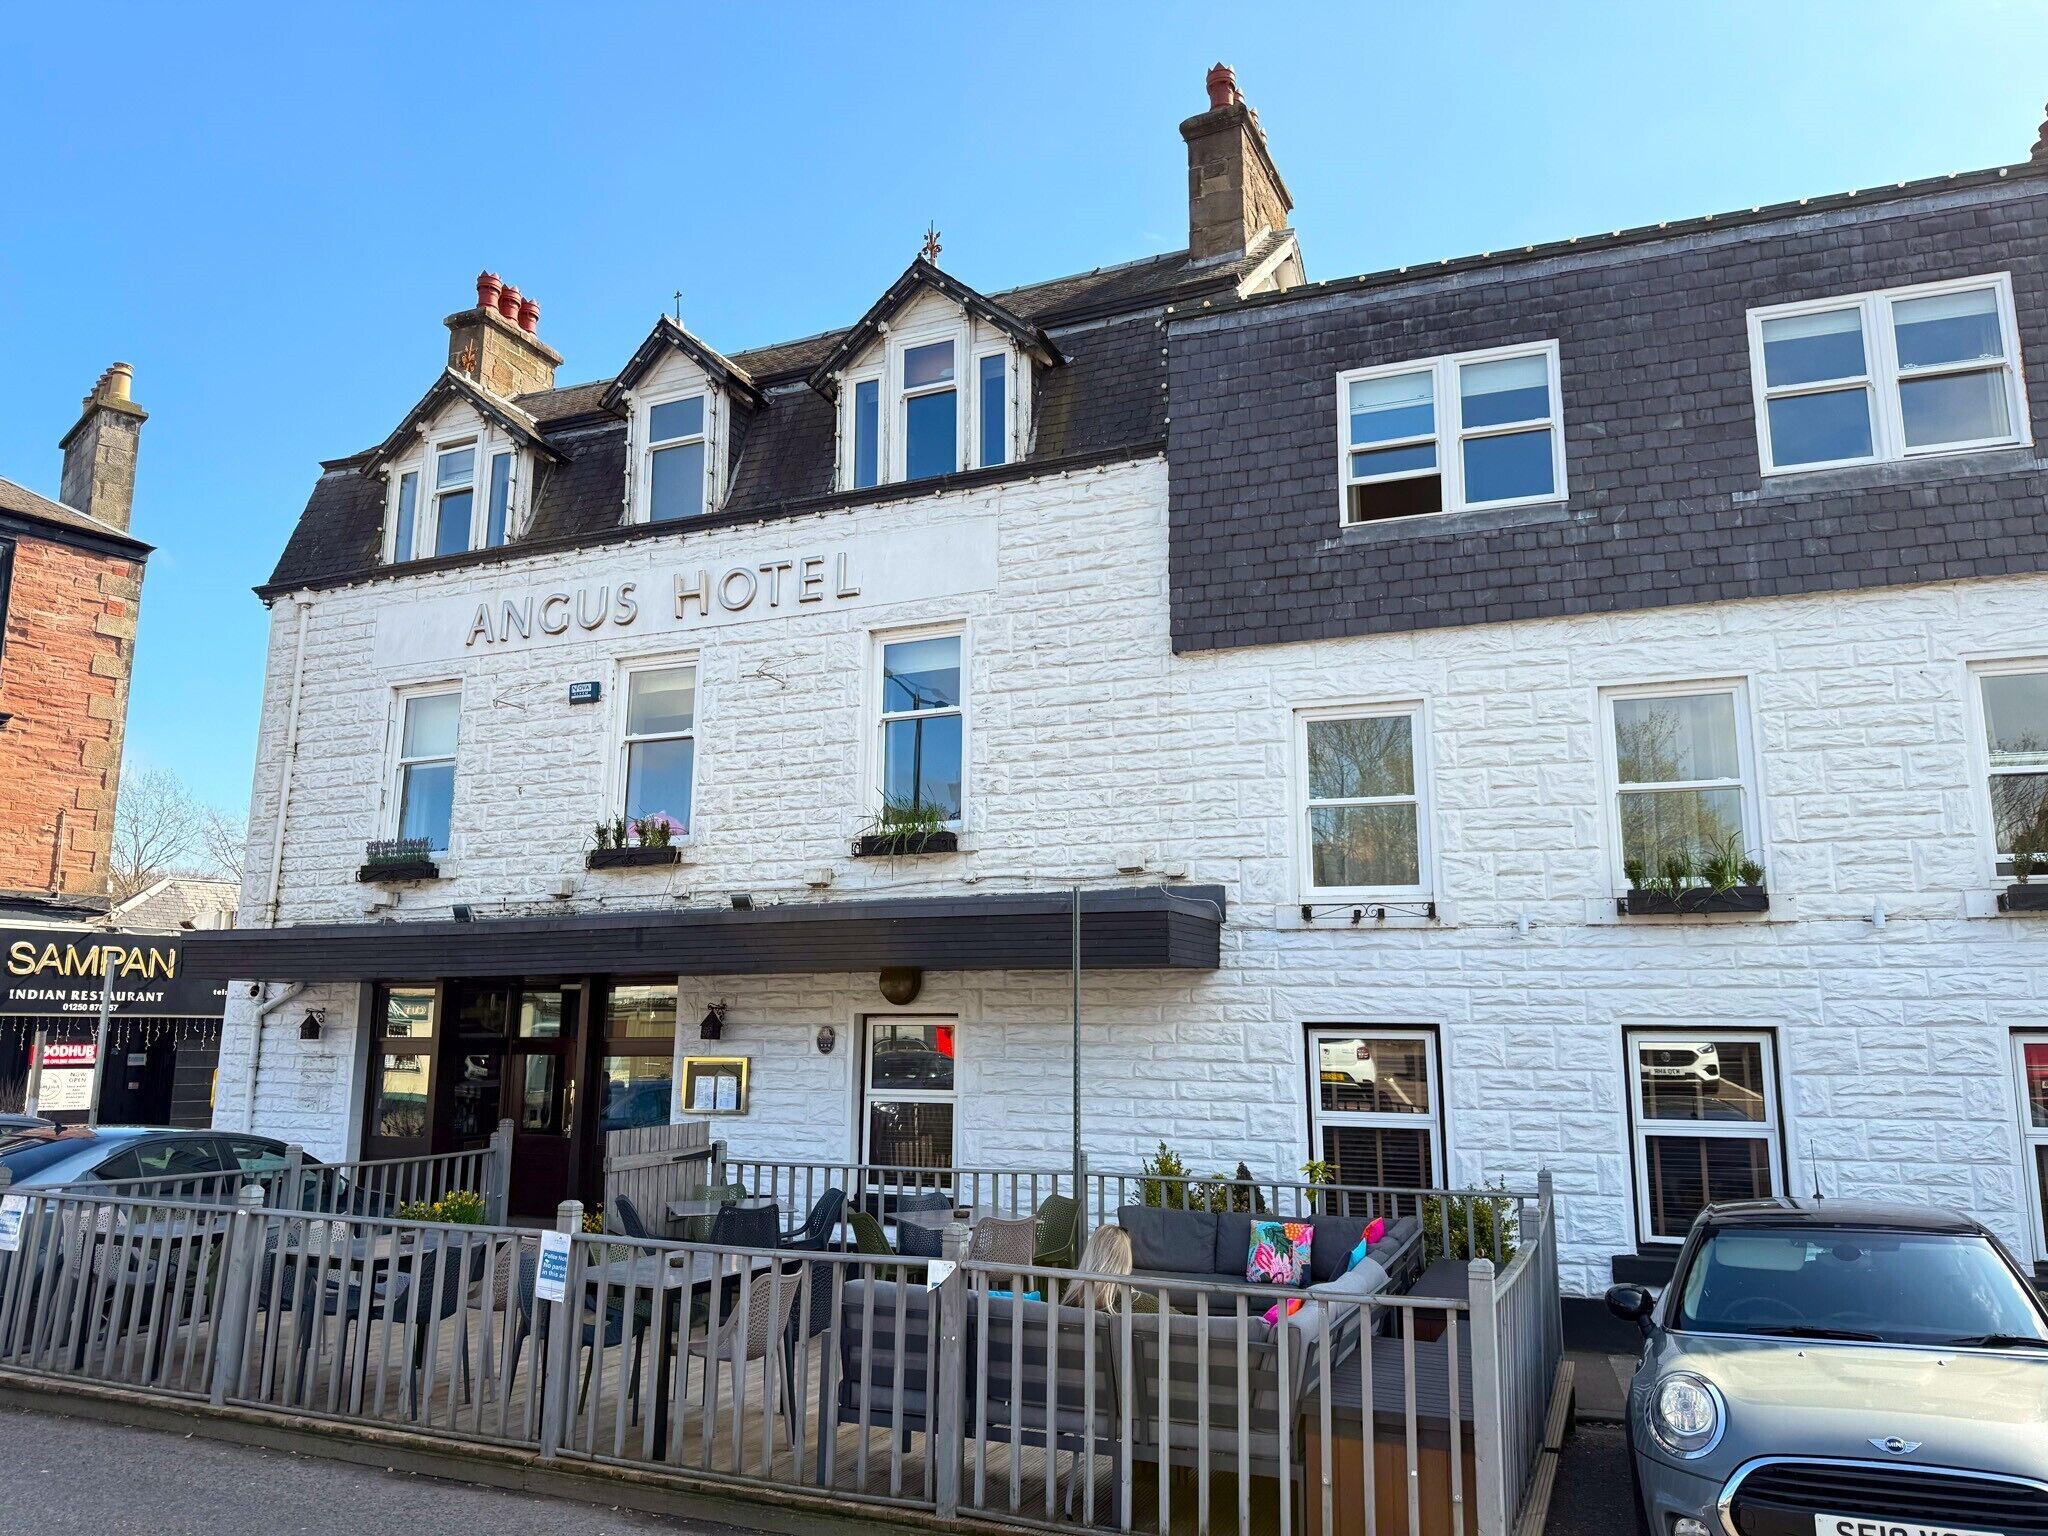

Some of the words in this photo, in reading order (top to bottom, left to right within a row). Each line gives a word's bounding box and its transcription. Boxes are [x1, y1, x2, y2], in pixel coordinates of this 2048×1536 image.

[466, 582, 638, 646] ANGUS
[673, 552, 861, 620] HOTEL
[7, 941, 176, 979] SAMPAN
[9, 989, 66, 1000] INDIAN
[71, 990, 164, 1002] RESTAURANT
[62, 1003, 88, 1011] 01250
[44, 1045, 95, 1058] OODHUB
